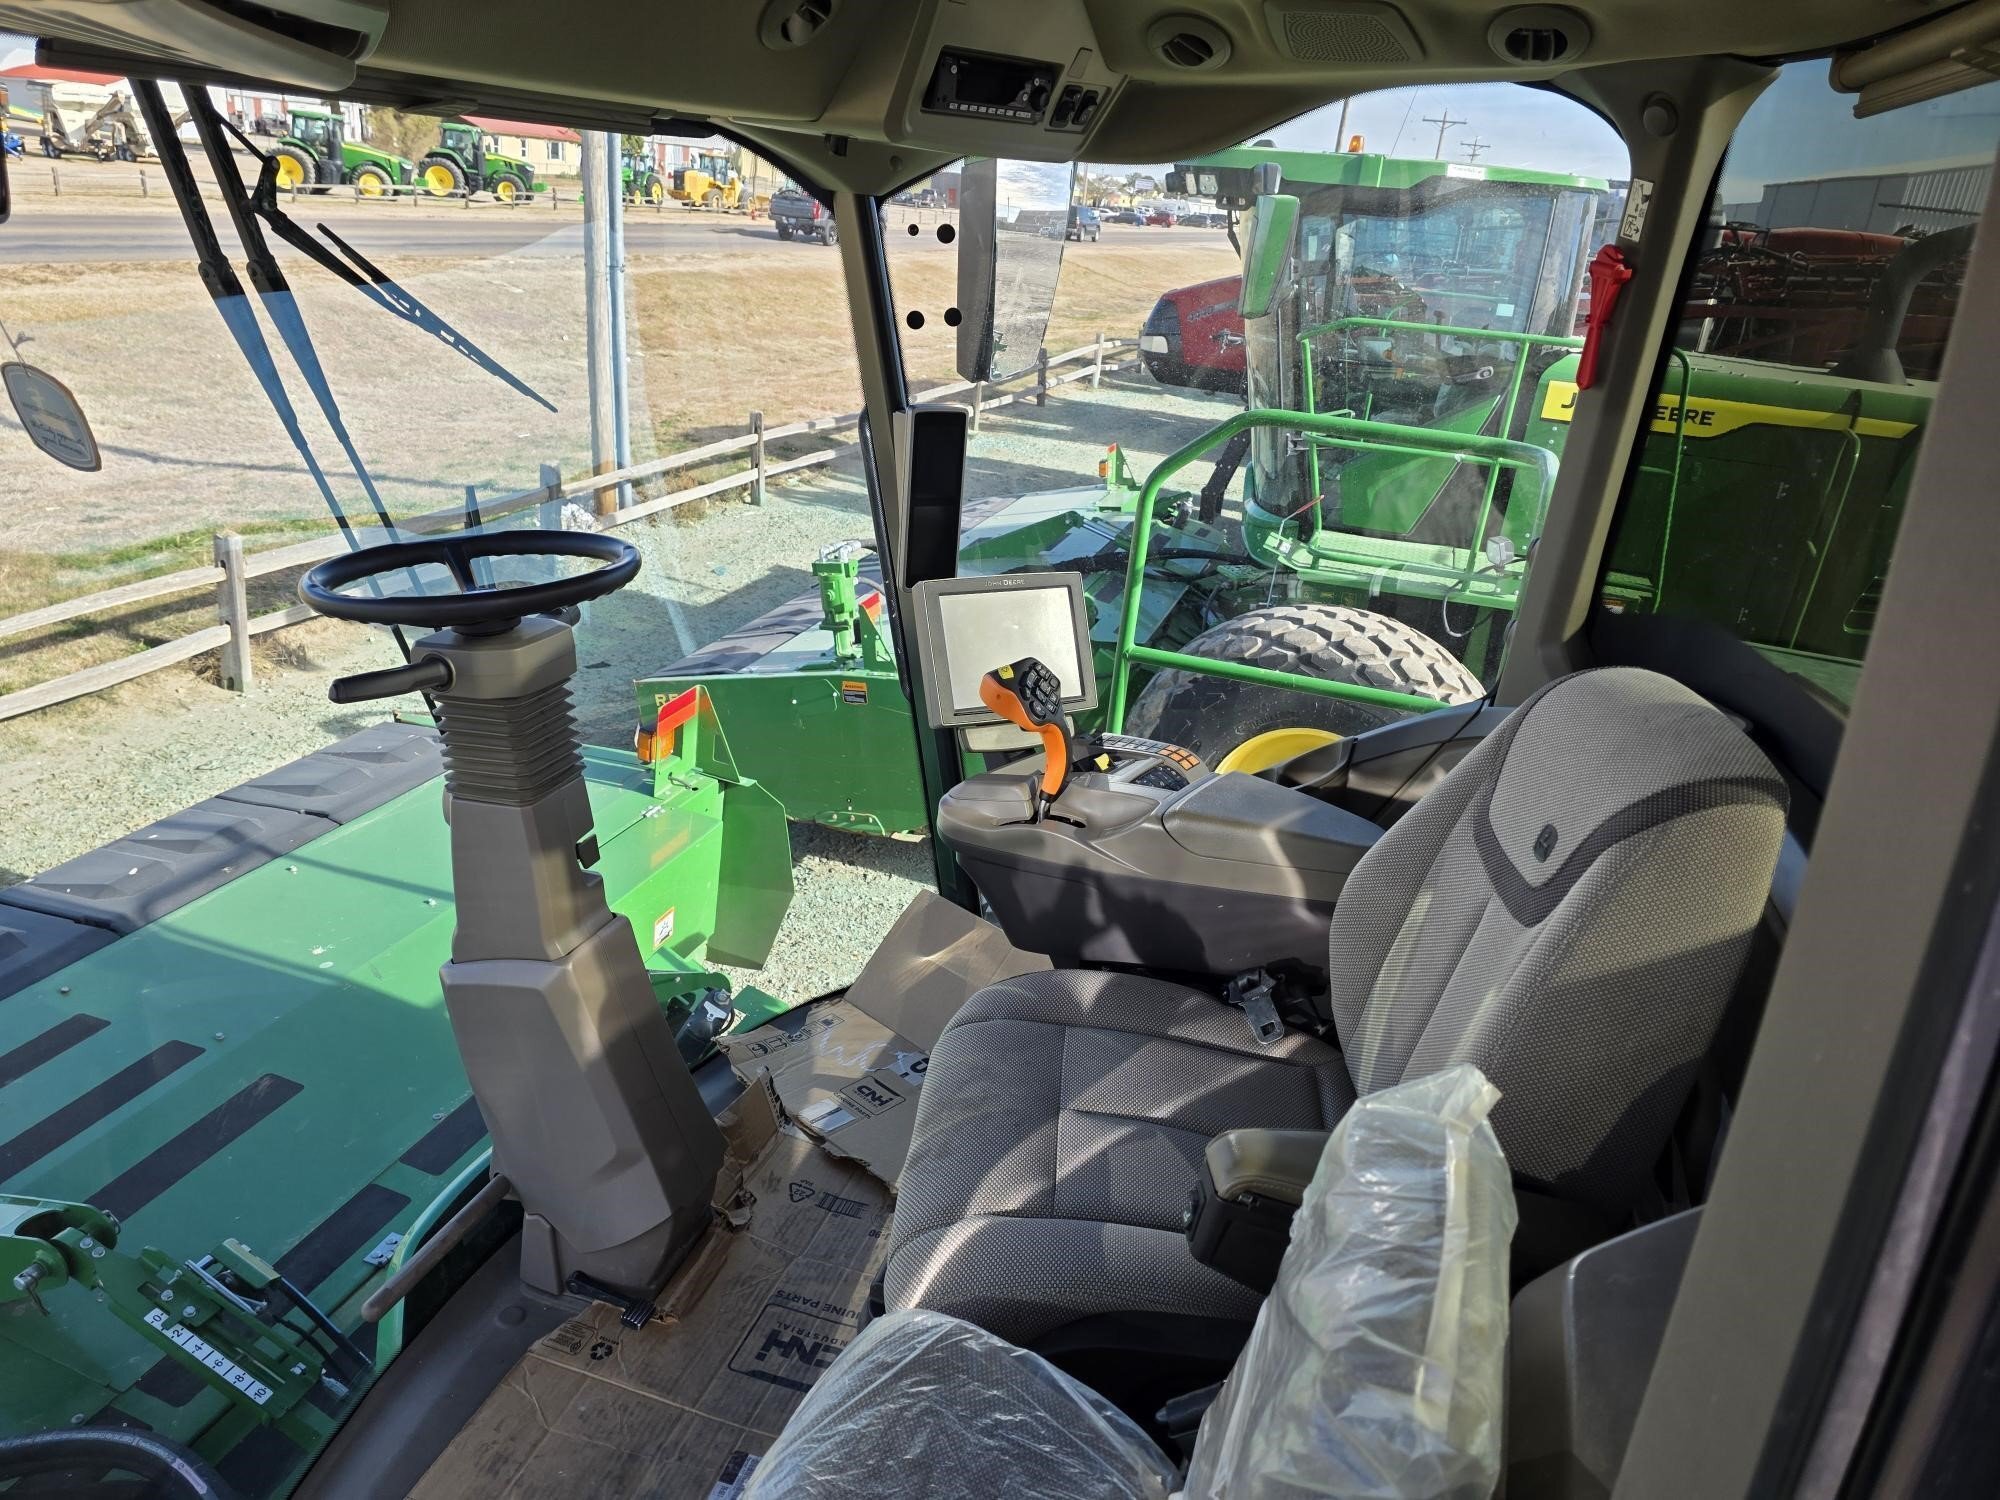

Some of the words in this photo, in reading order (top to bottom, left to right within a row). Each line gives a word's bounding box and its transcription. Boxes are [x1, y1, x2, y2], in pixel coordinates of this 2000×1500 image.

[1653, 406, 1715, 426] EERE
[776, 1289, 820, 1309] PARTS
[776, 1320, 849, 1347] NDUSTRIAL
